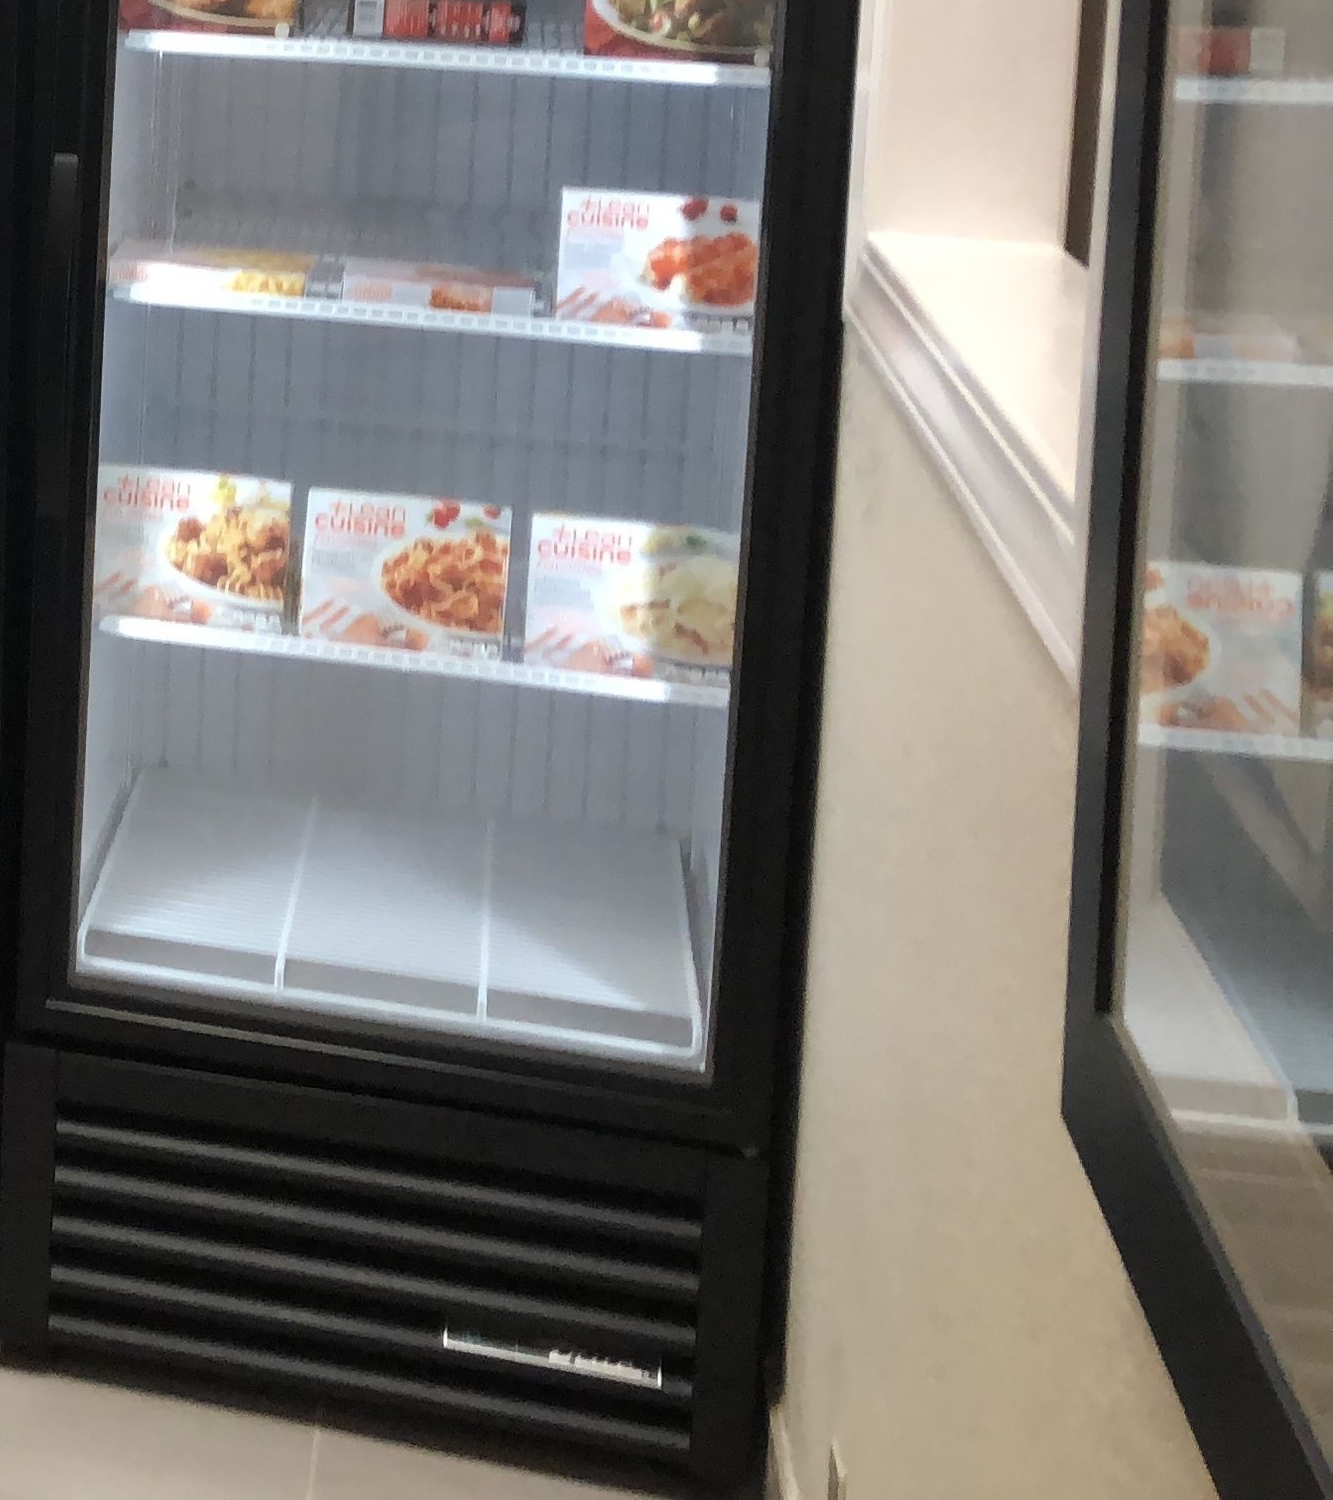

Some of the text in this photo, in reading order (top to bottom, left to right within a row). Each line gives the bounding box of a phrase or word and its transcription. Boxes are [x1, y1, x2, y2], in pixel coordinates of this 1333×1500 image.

[566, 209, 649, 233] cuisine
[102, 484, 190, 513] cuisine
[314, 512, 406, 540] cuisine
[536, 538, 632, 566] cuisine
